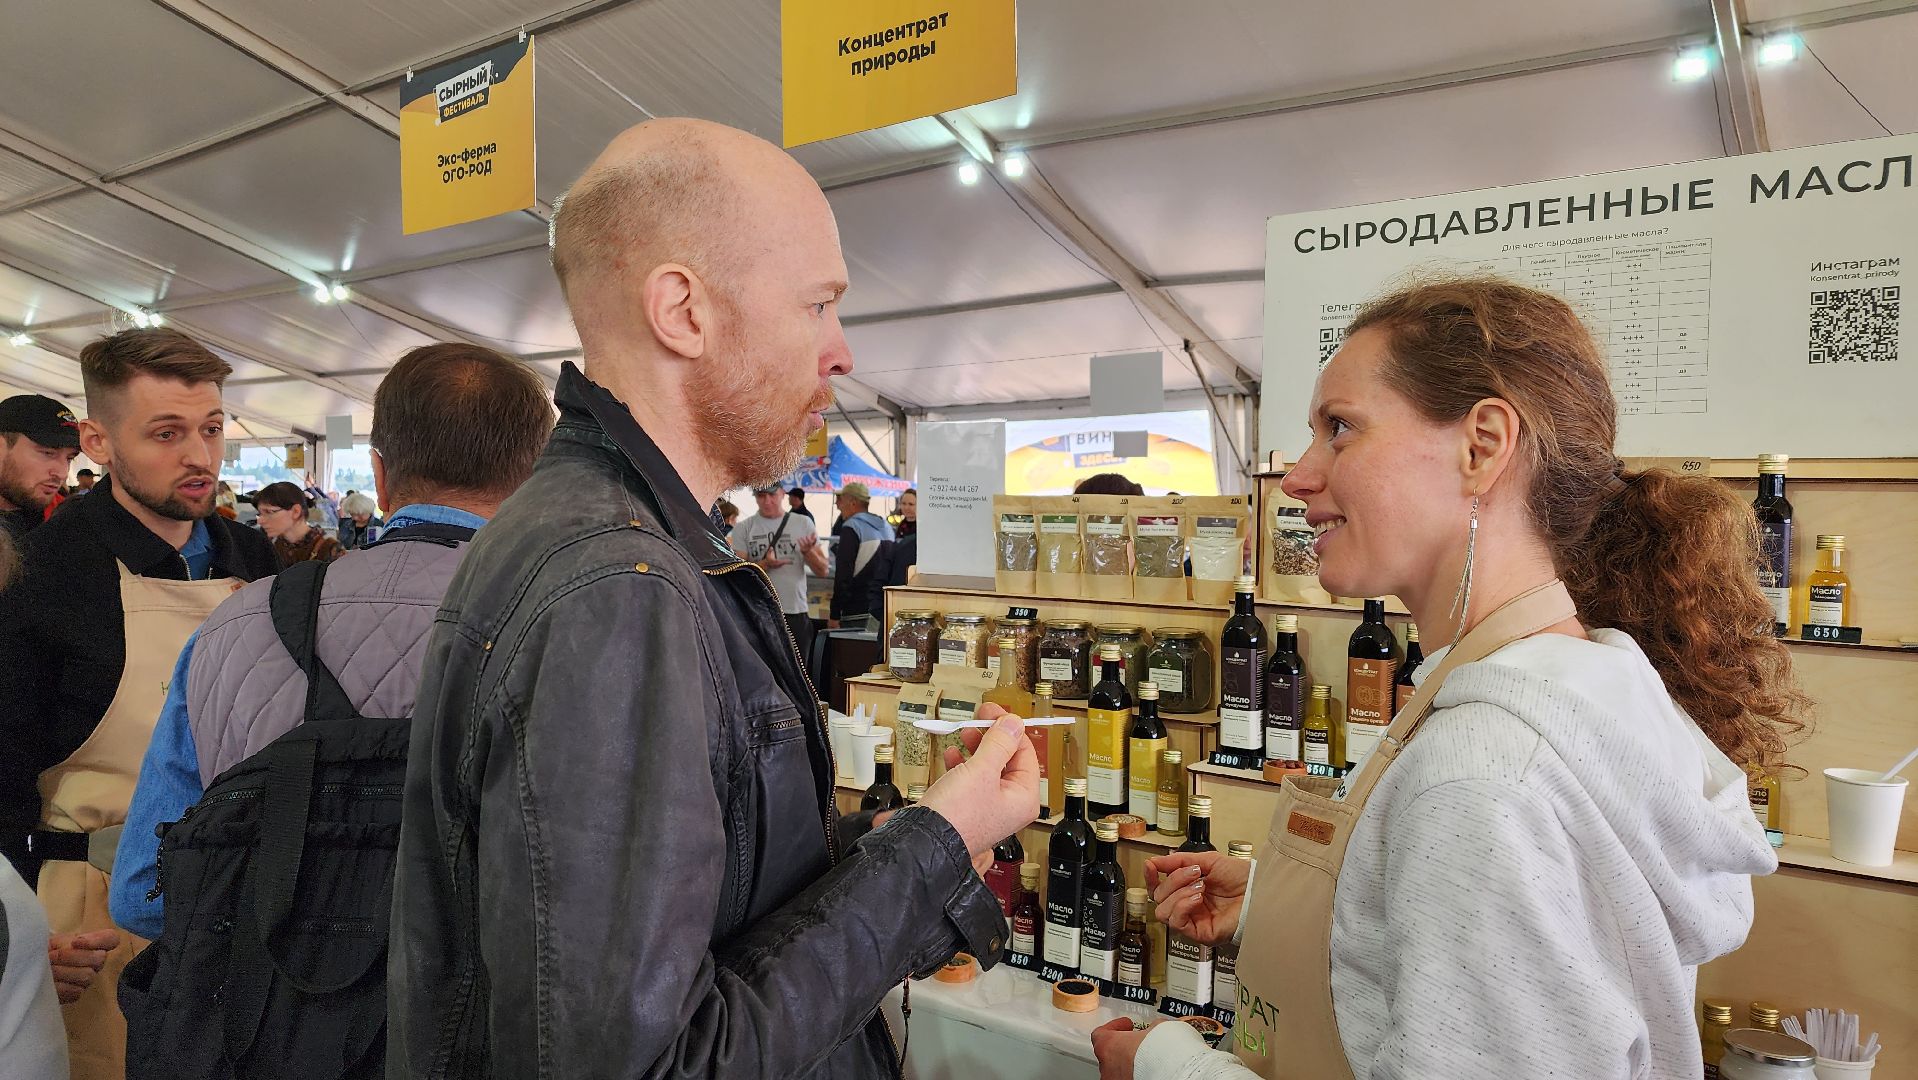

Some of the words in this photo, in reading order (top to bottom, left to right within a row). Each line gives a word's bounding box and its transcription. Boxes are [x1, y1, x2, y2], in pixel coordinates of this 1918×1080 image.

[838, 11, 949, 56] Концентрат
[851, 40, 936, 76] природы
[438, 66, 488, 103] СЫРНЫЙ
[443, 92, 485, 117] ФЕСТИВАЛЬ
[437, 142, 497, 168] Эко-ферма
[442, 159, 492, 183] ОГО-РОД
[1294, 178, 1714, 254] СЫРОДАВЛЕННЫЕ
[1501, 243, 1521, 253] Для
[1522, 240, 1544, 250] чего
[1546, 232, 1629, 248] сыродавленные
[1631, 227, 1670, 238] масла?
[1811, 257, 1900, 272] Инстаграм
[1320, 303, 1363, 313] Телегр
[1077, 431, 1112, 445] ВИН
[1811, 587, 1841, 596] Масло
[1014, 608, 1029, 617] 350
[1813, 627, 1840, 638] 650
[1223, 694, 1251, 704] Масло
[1268, 713, 1293, 722] Масло
[1350, 706, 1381, 718] Масло
[1305, 730, 1327, 739] Масло
[1089, 752, 1113, 763] Масло
[1214, 753, 1239, 766] 2600
[1306, 763, 1325, 775] 650
[1131, 775, 1151, 784] Масло
[1048, 901, 1074, 915] Масло
[1015, 915, 1034, 925] Масло
[1084, 926, 1107, 938] Масло
[1120, 944, 1141, 954] Масло
[1171, 939, 1200, 954] Масло
[1010, 953, 1029, 966] 850
[1041, 966, 1063, 981] 5200
[1124, 986, 1151, 1000] 1300
[1168, 1001, 1196, 1017] 2800
